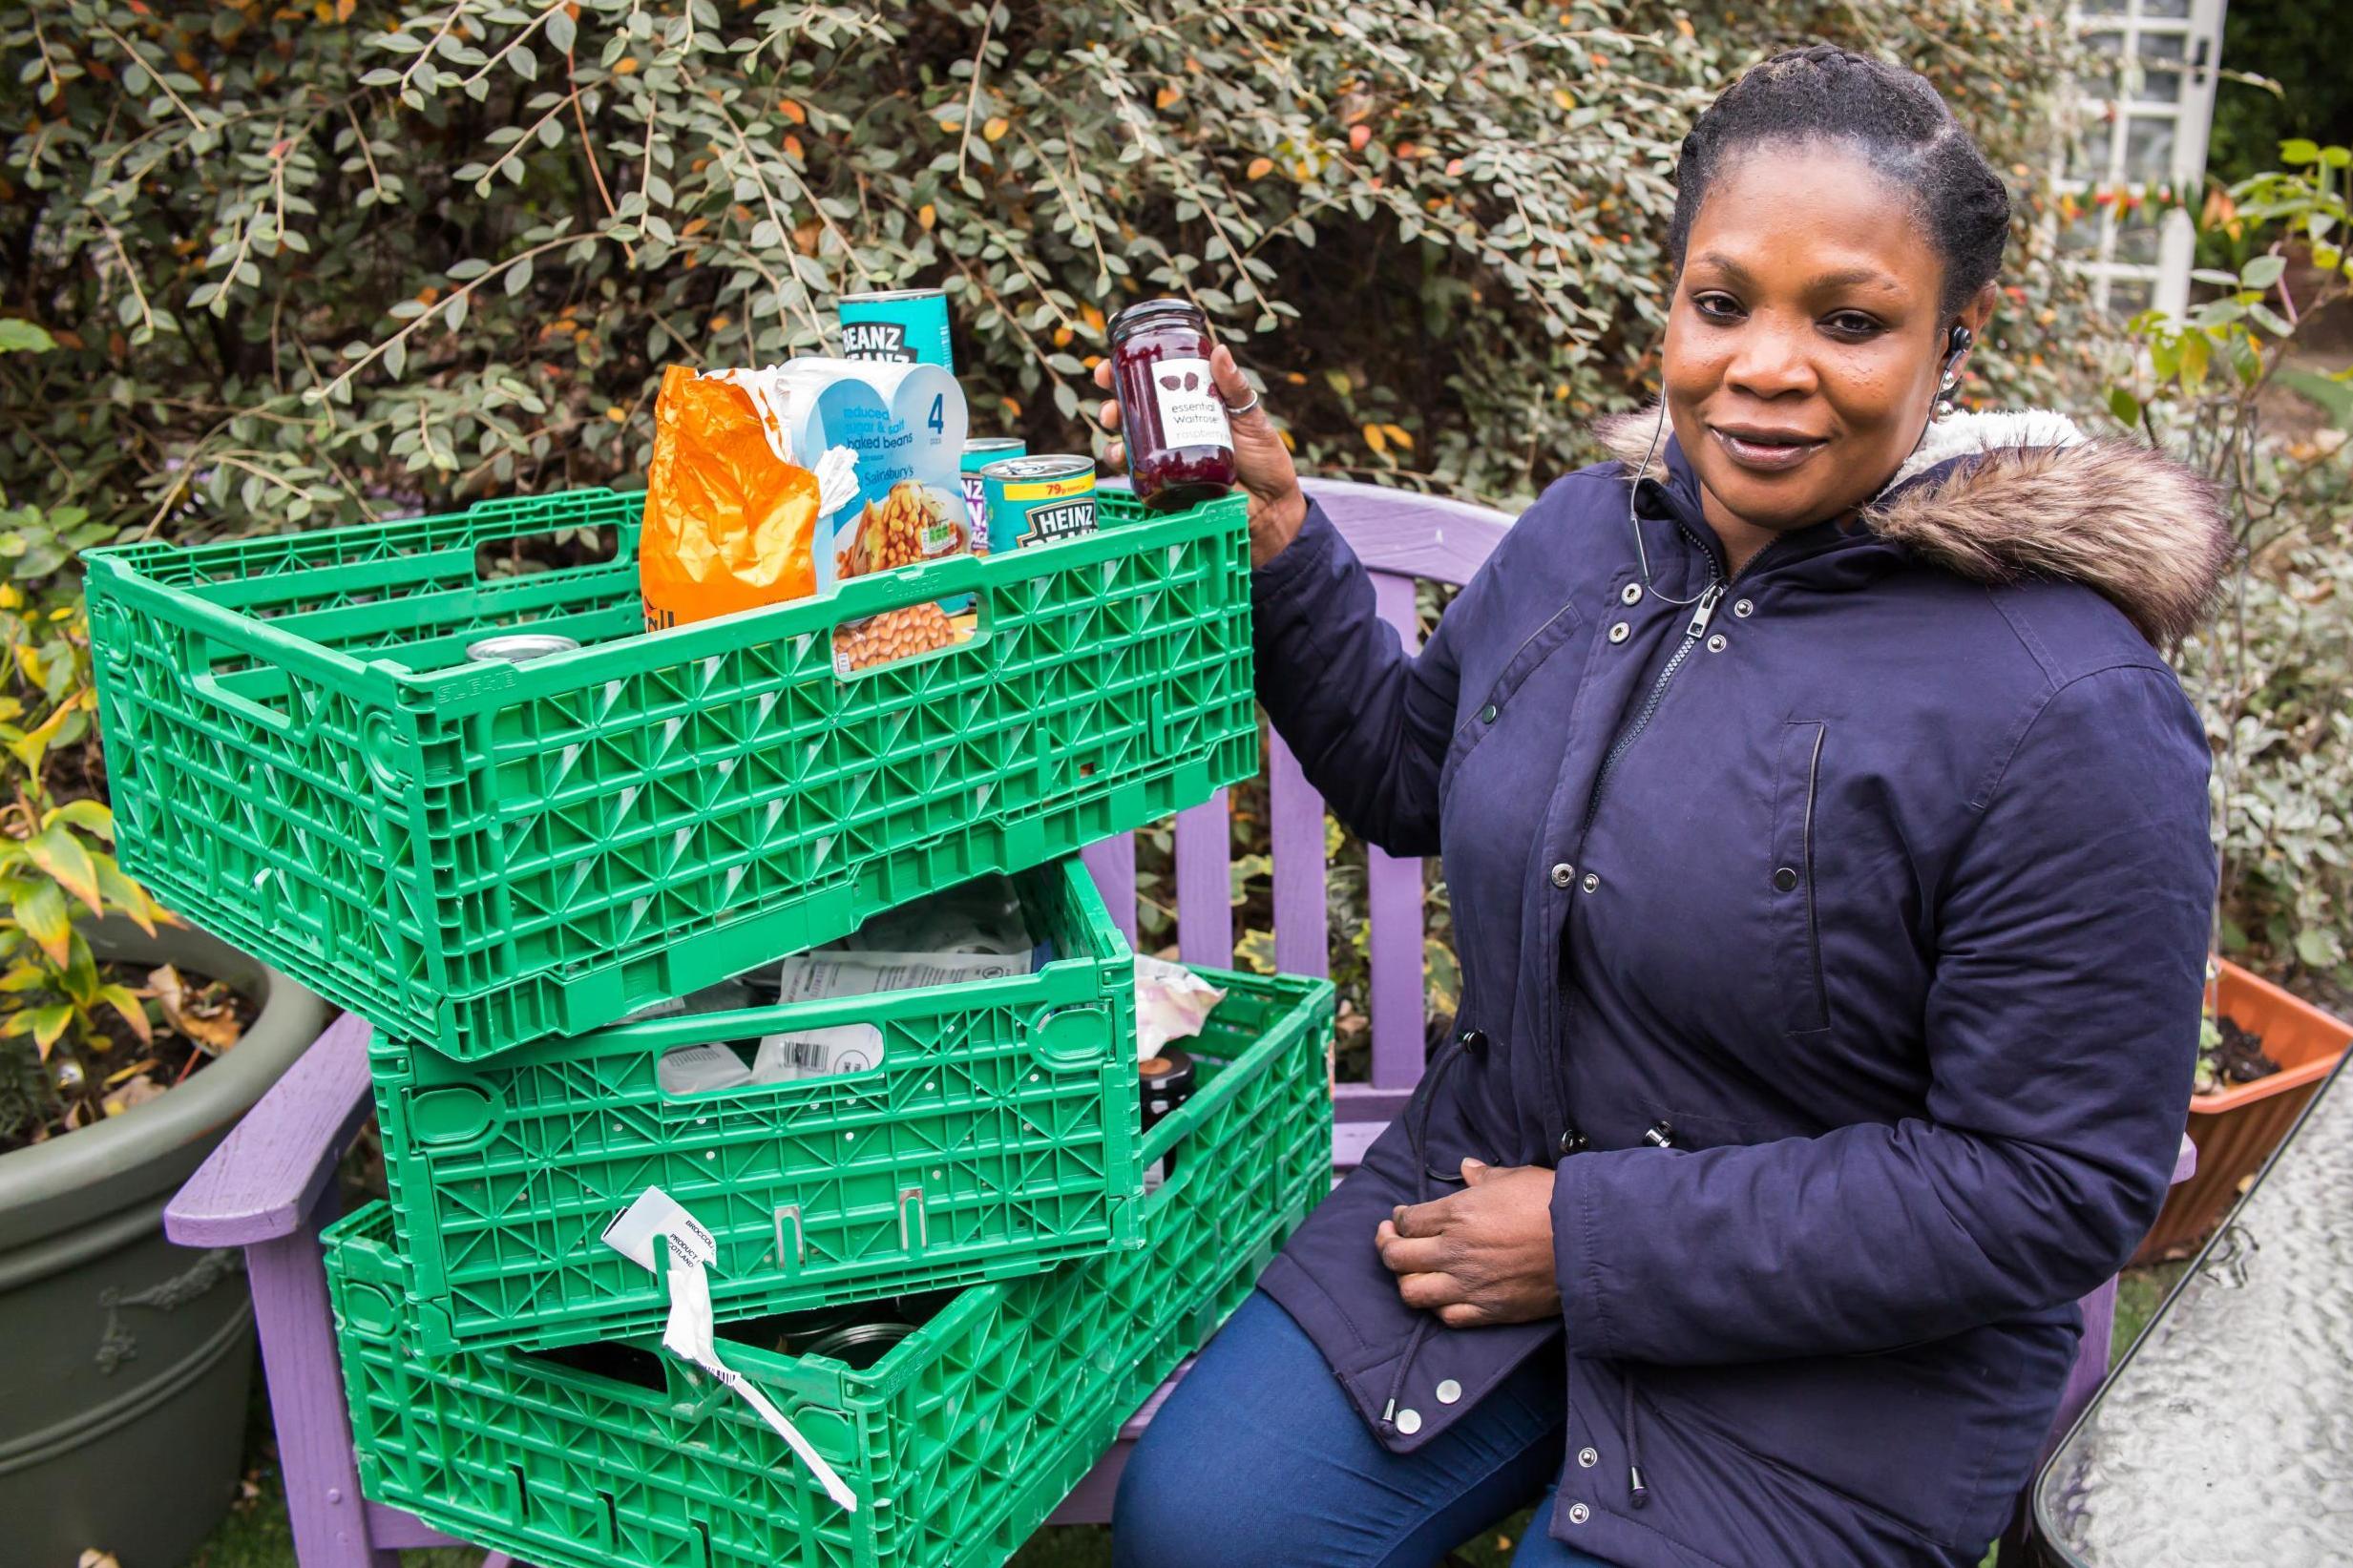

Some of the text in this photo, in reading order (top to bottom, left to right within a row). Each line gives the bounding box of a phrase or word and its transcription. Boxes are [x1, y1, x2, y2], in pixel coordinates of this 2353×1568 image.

[843, 407, 890, 420] reduced
[928, 392, 944, 434] 4
[847, 435, 880, 449] baked
[883, 432, 914, 449] beans
[863, 465, 914, 487] Sainsbury's
[1038, 505, 1094, 535] HEINZ
[668, 1243, 694, 1268] COTLAND
[669, 1233, 698, 1260] PRODUCT
